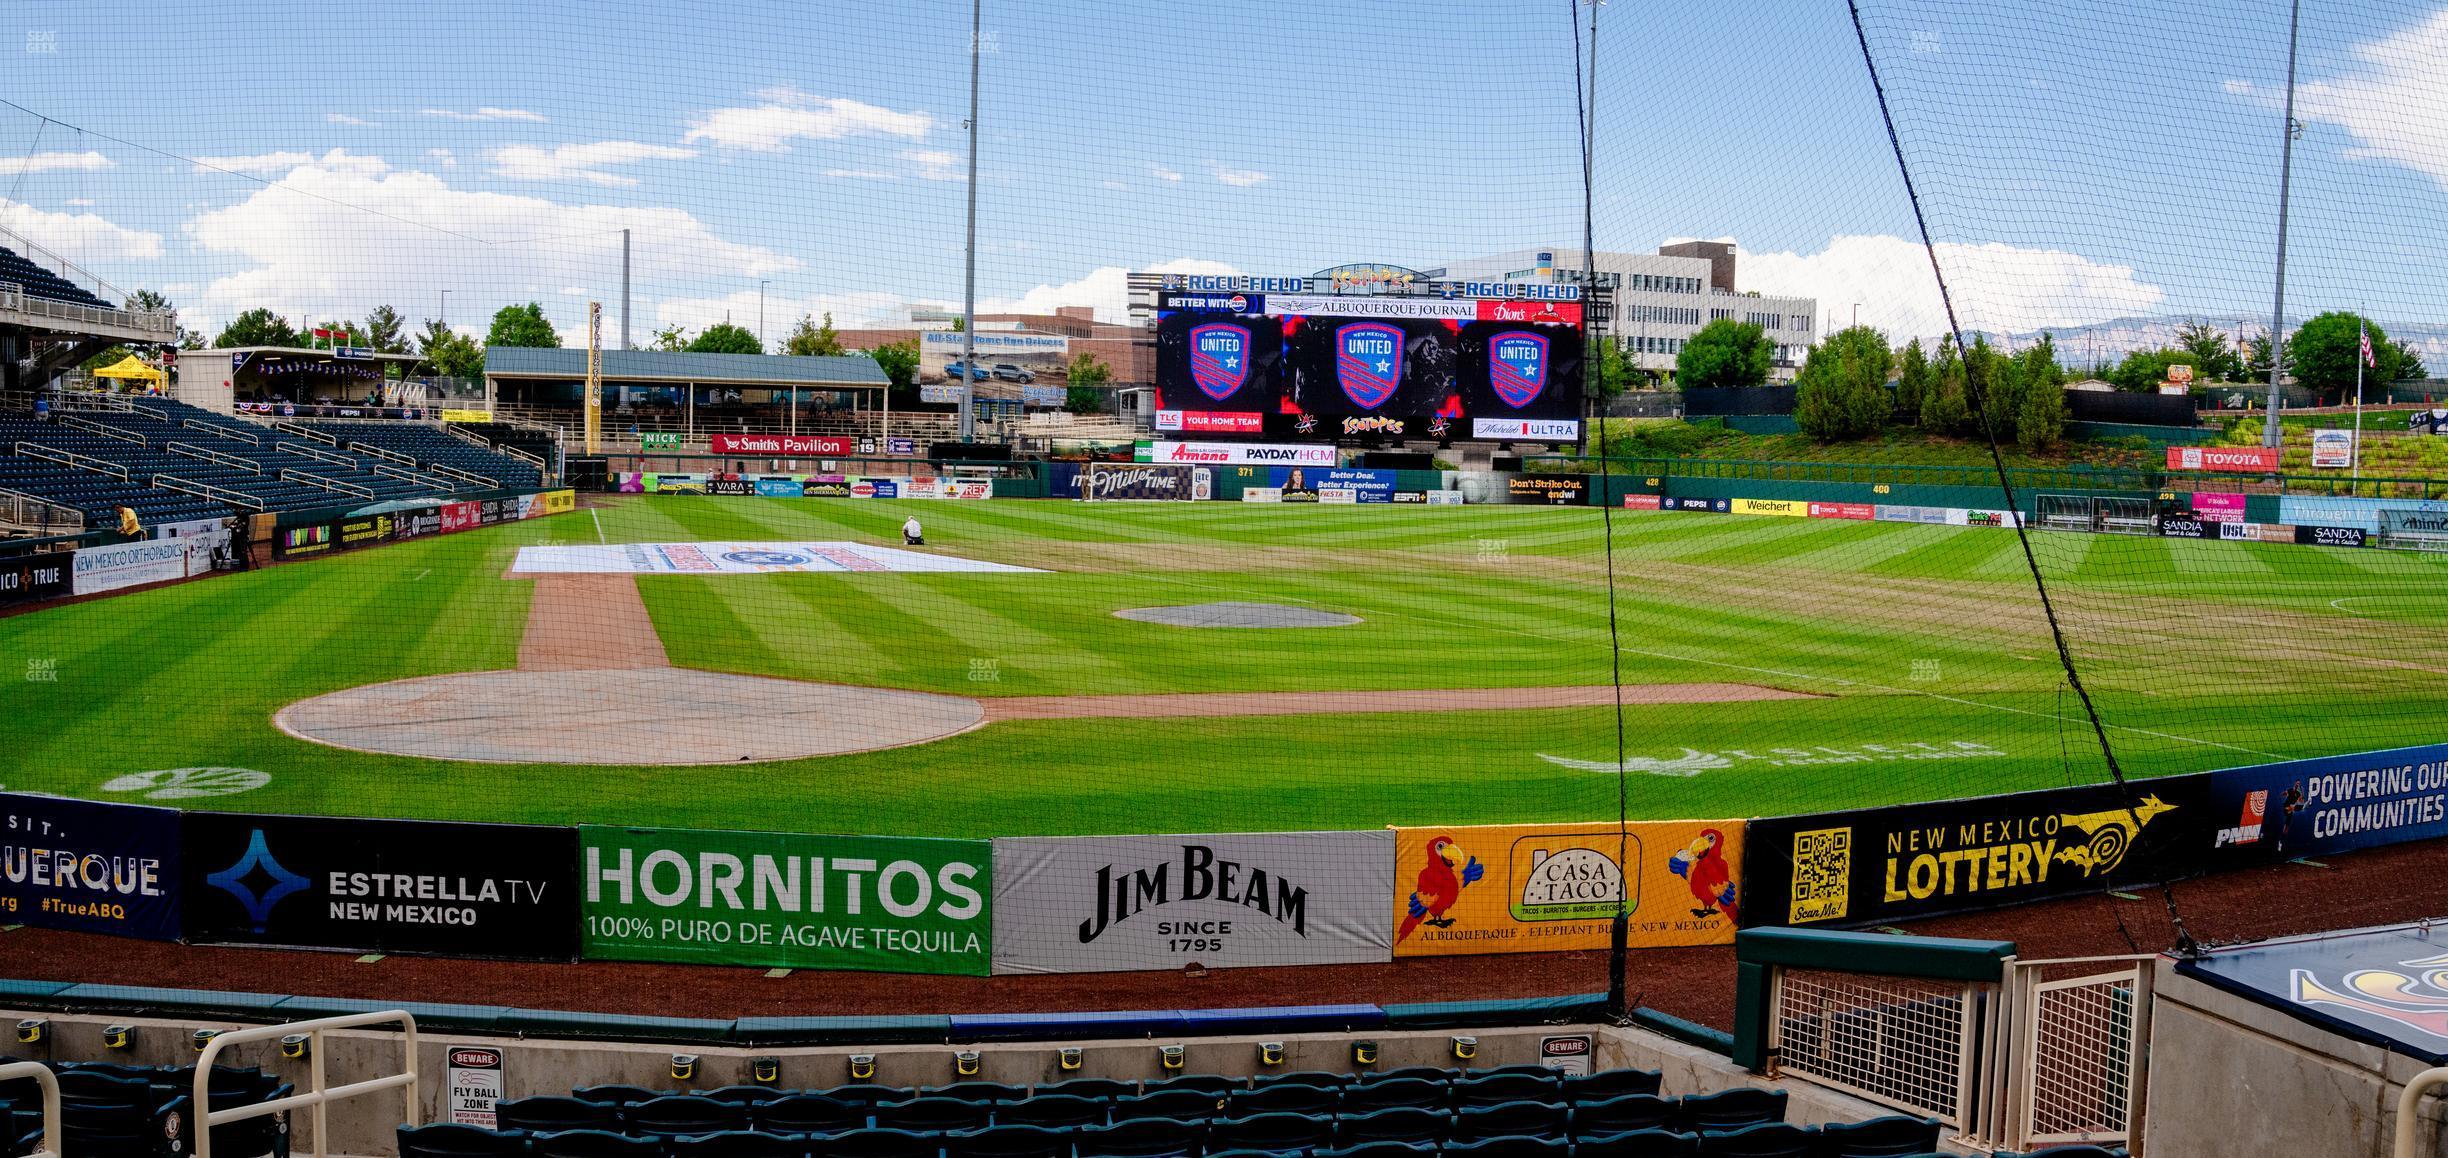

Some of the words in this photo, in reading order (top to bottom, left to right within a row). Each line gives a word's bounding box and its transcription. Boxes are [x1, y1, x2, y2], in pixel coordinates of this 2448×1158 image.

[1187, 275, 1240, 291] RGCU
[1249, 276, 1304, 293] FIELD
[1464, 282, 1517, 298] RGCU
[1525, 283, 1580, 300] FIELD
[1168, 298, 1206, 308] BETTER
[1208, 298, 1233, 308] WITH
[1322, 302, 1416, 316] ALBUQUERQUE
[1418, 304, 1475, 316] JOURNAL
[1494, 303, 1525, 320] Dion's
[927, 334, 965, 344] All-Sta
[1202, 338, 1240, 352] UNITED
[1349, 339, 1392, 355] UNITED
[1500, 346, 1538, 360] UNITED
[1160, 414, 1177, 422] TLC
[1187, 416, 1208, 424] YOUR
[1212, 418, 1234, 426] HOME
[1237, 418, 1260, 426] TEAM
[1342, 416, 1404, 434] ISOTOPES
[1477, 422, 1519, 434] Michelob
[1531, 425, 1573, 435] ULTRA
[646, 434, 677, 442] NICK
[741, 438, 780, 451] Smith's
[784, 439, 840, 452] Pavilion
[860, 444, 874, 452] 19
[1171, 444, 1230, 462] Amana
[1246, 449, 1298, 460] PAYDAY
[1300, 450, 1334, 461] HCM
[2205, 454, 2262, 466] TOYOTA
[1238, 468, 1253, 477] 371
[1356, 472, 1376, 480] Deal.
[716, 482, 744, 490] VARA
[1092, 468, 1156, 496] Miller
[1146, 476, 1177, 488] TIME
[1317, 481, 1342, 489] Better
[1510, 479, 1534, 488] Don't
[1535, 480, 1562, 489] Strike
[1563, 480, 1582, 489] Out.
[1646, 478, 1660, 486] 428
[1872, 486, 1890, 494] 400
[1684, 500, 1707, 508] PEPSI
[1746, 500, 1791, 512] Weichert
[2203, 514, 2244, 523] NETWORK
[2294, 506, 2352, 522] Through
[2162, 520, 2203, 532] SANDIA
[2314, 528, 2362, 540] SANDIA
[75, 556, 94, 572] NEW
[94, 550, 128, 570] MEXICO
[129, 544, 183, 565] ORTHOPAEDICS
[34, 568, 60, 584] TRUE
[2308, 765, 2412, 805] POWERING
[2314, 793, 2445, 839] COMMUNITIES
[1888, 827, 1946, 853] NEW
[1960, 814, 2060, 845] MEXICO
[2214, 823, 2262, 849] PNM
[1545, 863, 1606, 882] CASA
[1884, 839, 2058, 903] LOTTERY
[586, 846, 984, 921] HORNITOS
[1545, 880, 1608, 901] TACO
[1078, 862, 1170, 944] JIM
[1179, 844, 1310, 940] BEAM
[42, 898, 124, 919] #TrueABQ
[330, 902, 380, 921] NEW
[386, 904, 478, 926] MEXICO
[1543, 906, 1569, 914] BURRITOS
[1794, 906, 1820, 920] Scan
[1819, 902, 1842, 918] Me!
[587, 914, 654, 940] 100%
[661, 918, 731, 943] PURO
[740, 922, 773, 946] DE
[780, 924, 866, 949] AGAVE
[870, 928, 982, 955] TEQUILA
[1157, 921, 1232, 935] SINCE
[1420, 927, 1518, 941] ALBUQUERQUE
[1530, 924, 1593, 936] ELEPHANT
[1598, 923, 1636, 934] BUE
[1641, 921, 1669, 933] NEW
[1674, 919, 1720, 931] MEXICO
[1168, 938, 1222, 952] 1795
[1549, 1042, 1583, 1051] BEWARE
[457, 1054, 494, 1064] BEWARE
[454, 1087, 470, 1097] FLY
[474, 1088, 498, 1098] BALL
[464, 1098, 489, 1109] ZONE
